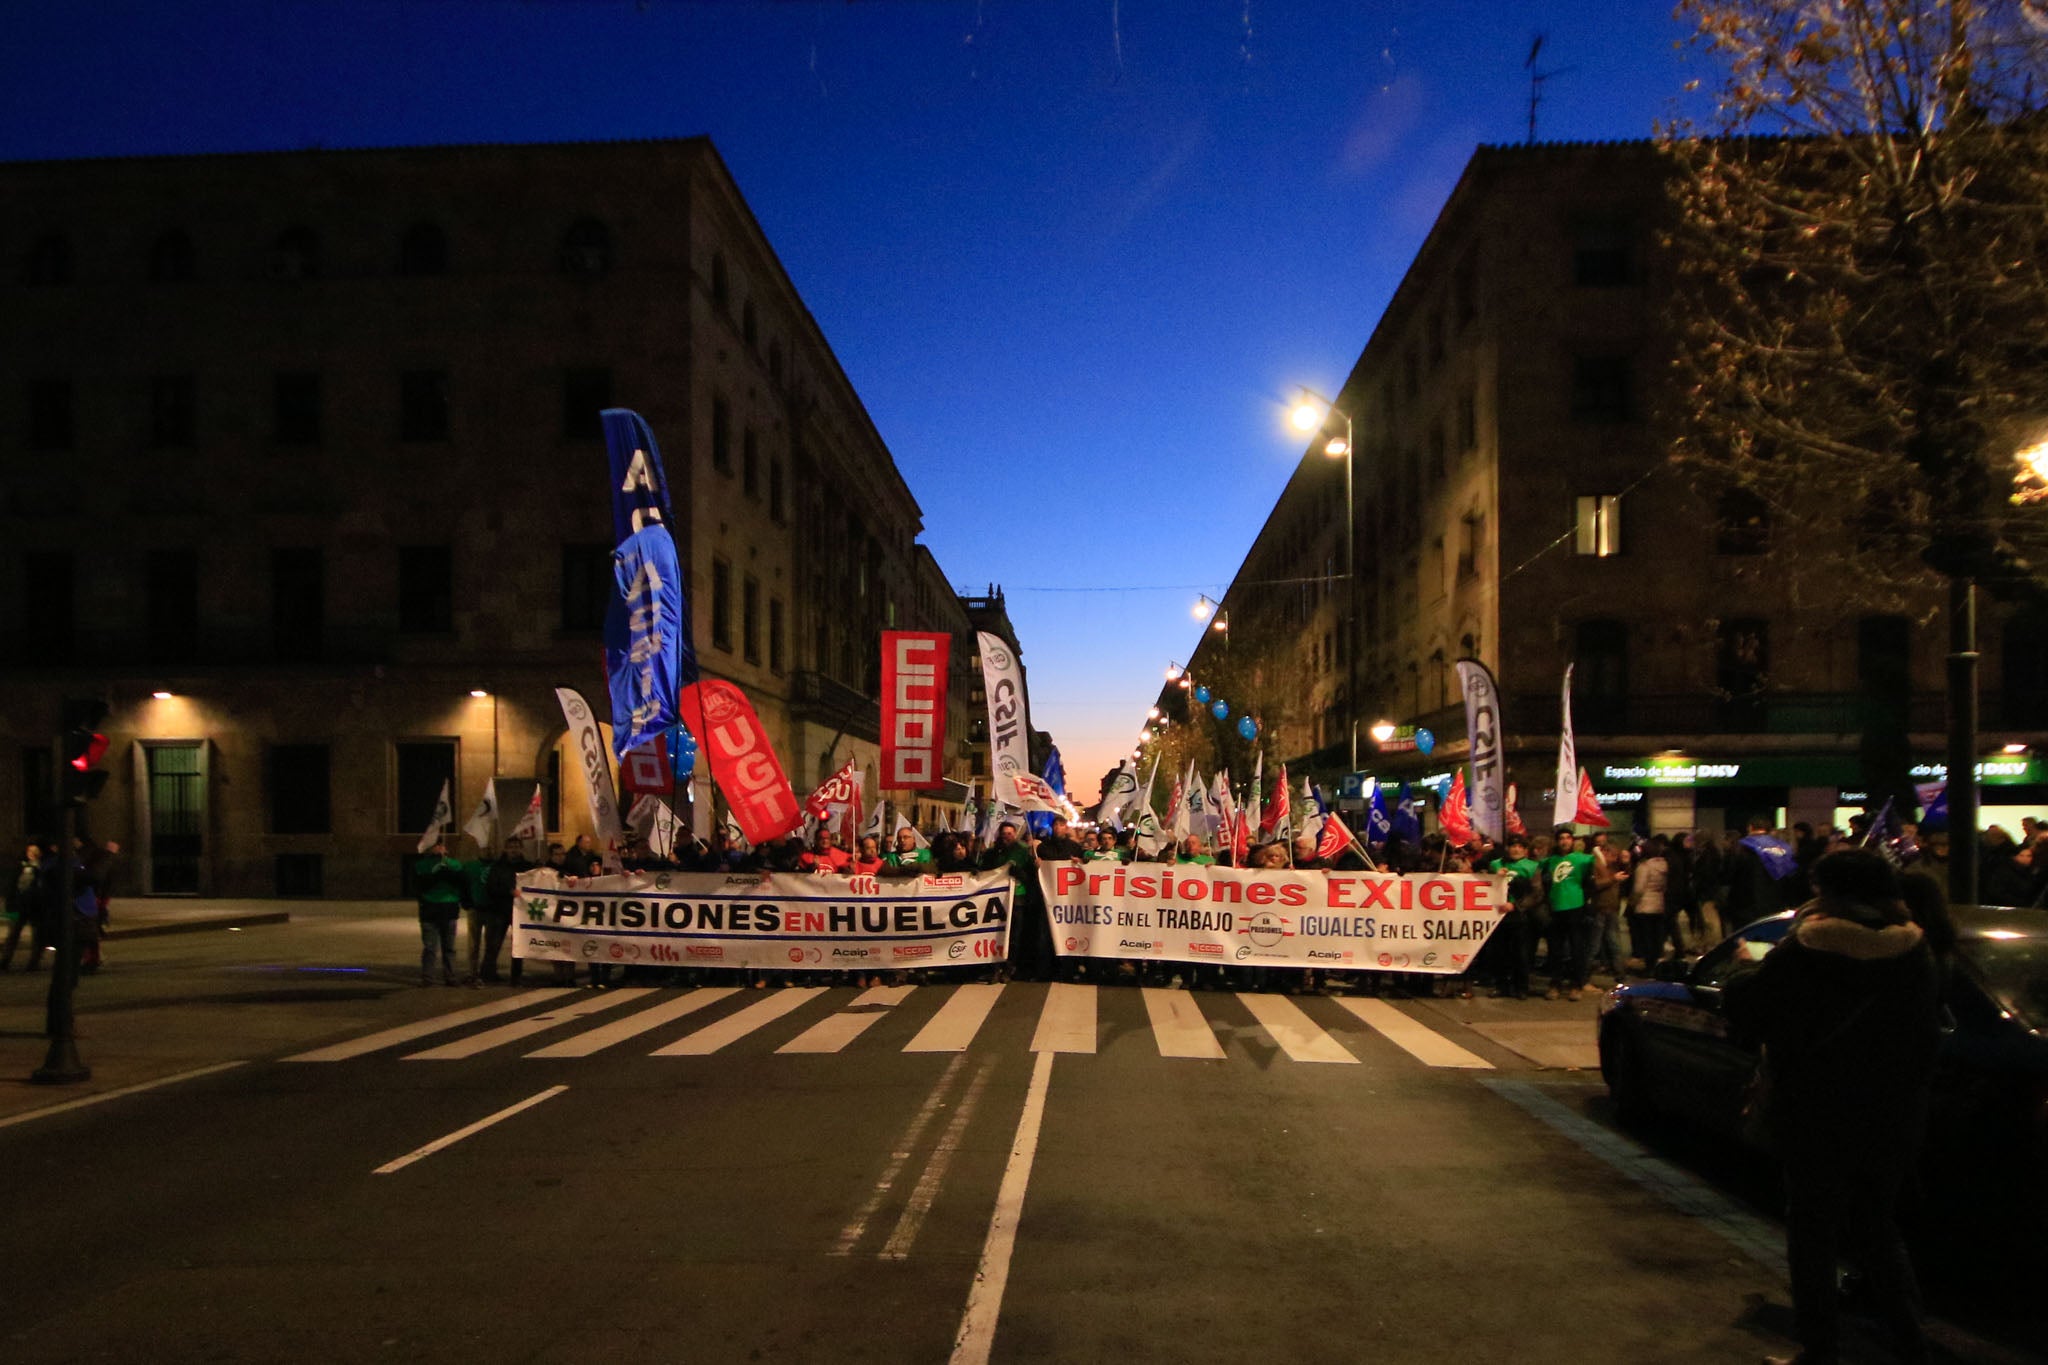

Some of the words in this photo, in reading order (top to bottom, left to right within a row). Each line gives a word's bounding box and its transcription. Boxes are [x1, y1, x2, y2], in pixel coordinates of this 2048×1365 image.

[894, 638, 936, 783] CCOO
[713, 714, 785, 824] UGT
[1604, 766, 1646, 779] Espacio
[1646, 767, 1662, 777] de
[1663, 765, 1697, 777] Salud
[1697, 764, 1739, 777] DKV
[1982, 762, 2027, 775] DKV
[1617, 793, 1643, 801] DKV
[1056, 867, 1308, 906] Prisiones
[1327, 878, 1493, 911] EXIGE
[1053, 905, 1113, 925] GUALES
[1118, 912, 1134, 926] EN
[1137, 912, 1152, 928] EL
[1157, 908, 1233, 932] TRABAJO
[1300, 916, 1375, 938] IGUALES
[1381, 924, 1398, 939] EN
[1402, 924, 1417, 940] EL
[1423, 919, 1497, 941] SALARI
[1119, 939, 1152, 949] Acaip
[832, 948, 868, 958] Acaip
[1308, 950, 1342, 960] Acaip
